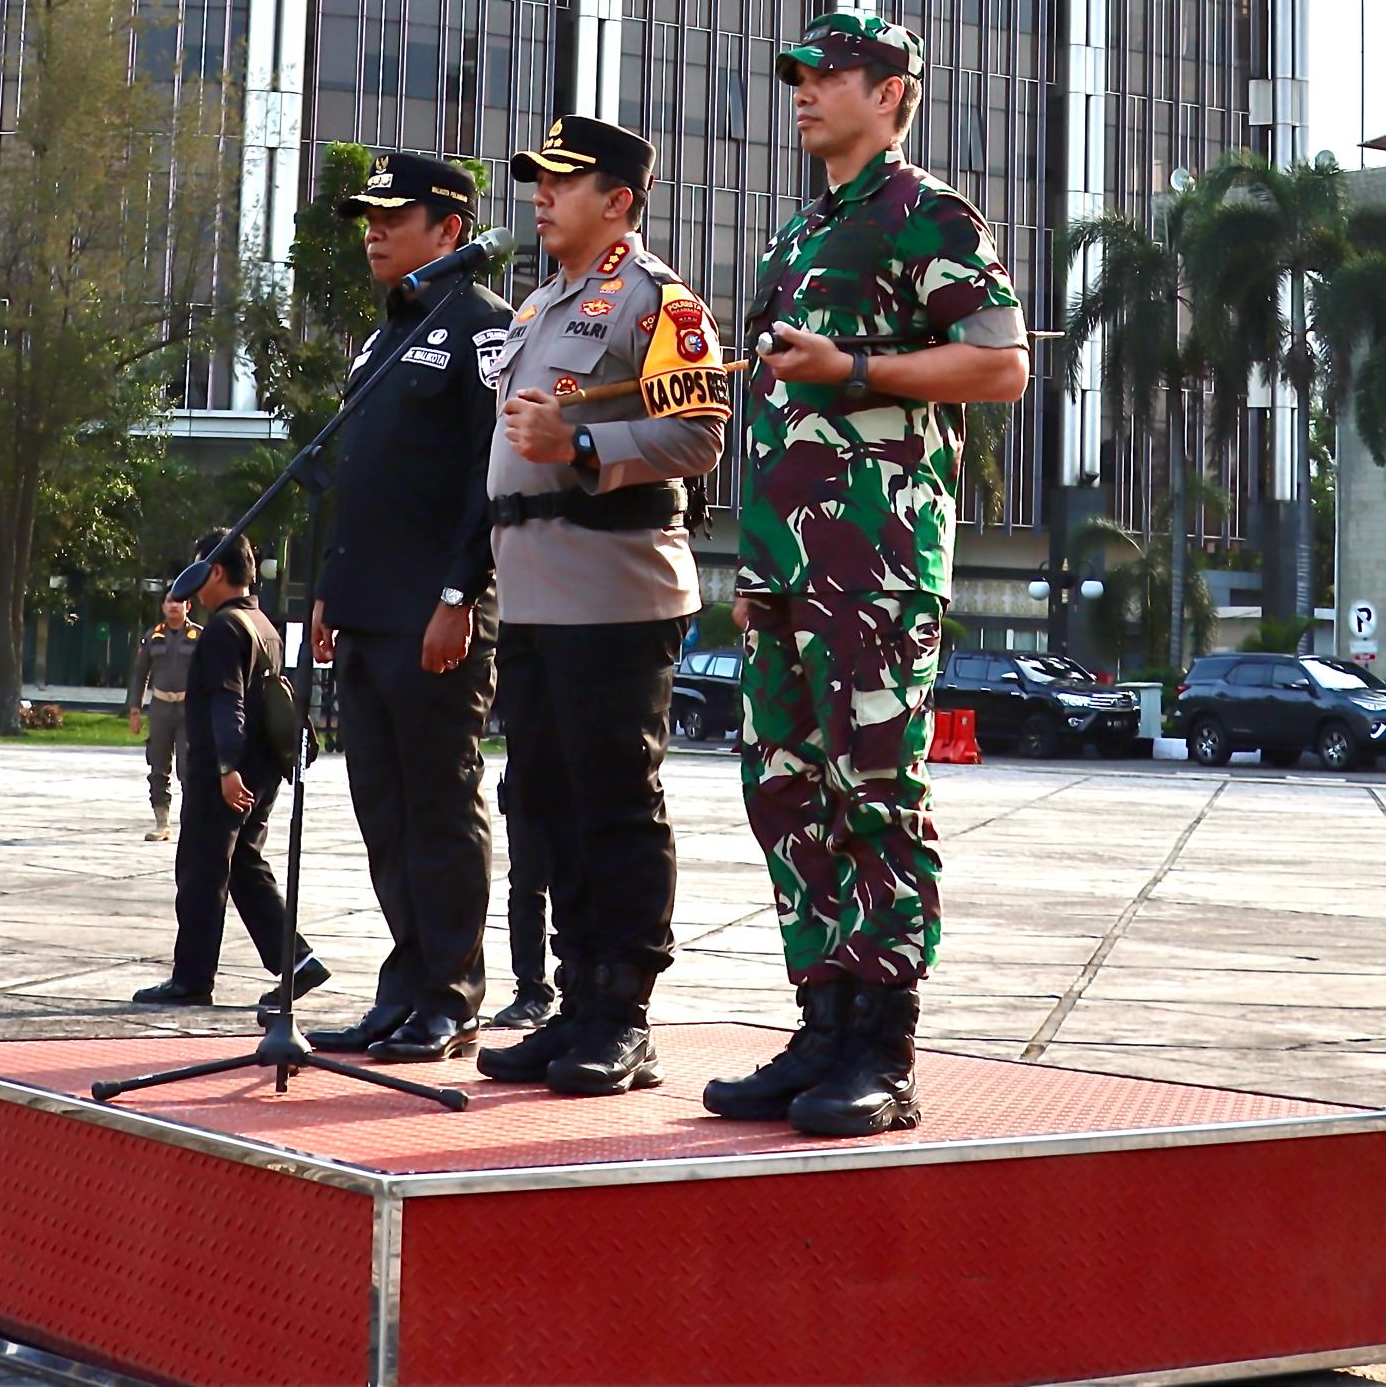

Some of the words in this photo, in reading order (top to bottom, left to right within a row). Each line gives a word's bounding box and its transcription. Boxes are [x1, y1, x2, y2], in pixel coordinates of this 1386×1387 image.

[564, 320, 608, 340] POLRI
[644, 377, 671, 415] KA
[669, 370, 707, 407] OPS
[1356, 607, 1372, 633] P
